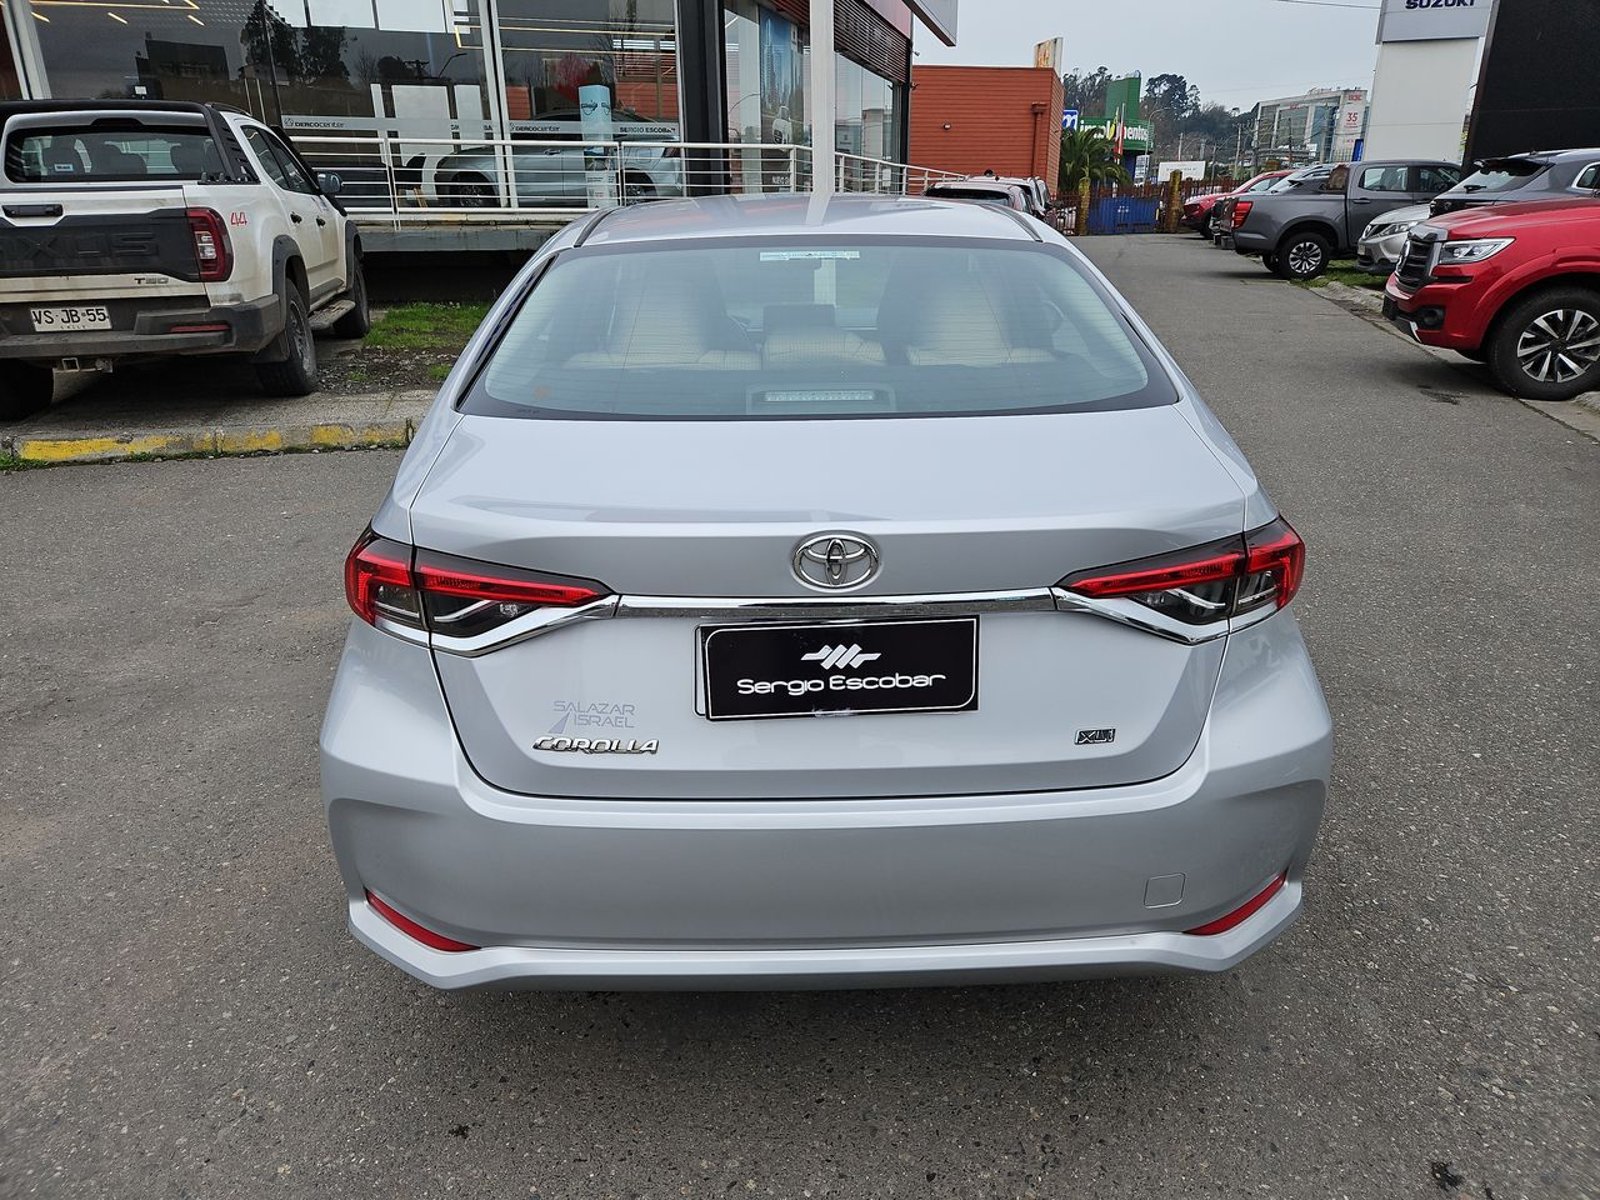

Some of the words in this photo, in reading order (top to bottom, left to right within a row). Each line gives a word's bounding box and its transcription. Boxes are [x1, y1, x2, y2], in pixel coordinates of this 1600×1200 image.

[1404, 0, 1476, 9] SUZUKI
[736, 679, 825, 696] Sergio
[829, 672, 946, 690] Escobar
[553, 700, 636, 716] SALAZAR
[574, 714, 635, 729] ISRAEL
[531, 736, 660, 755] COROLLA
